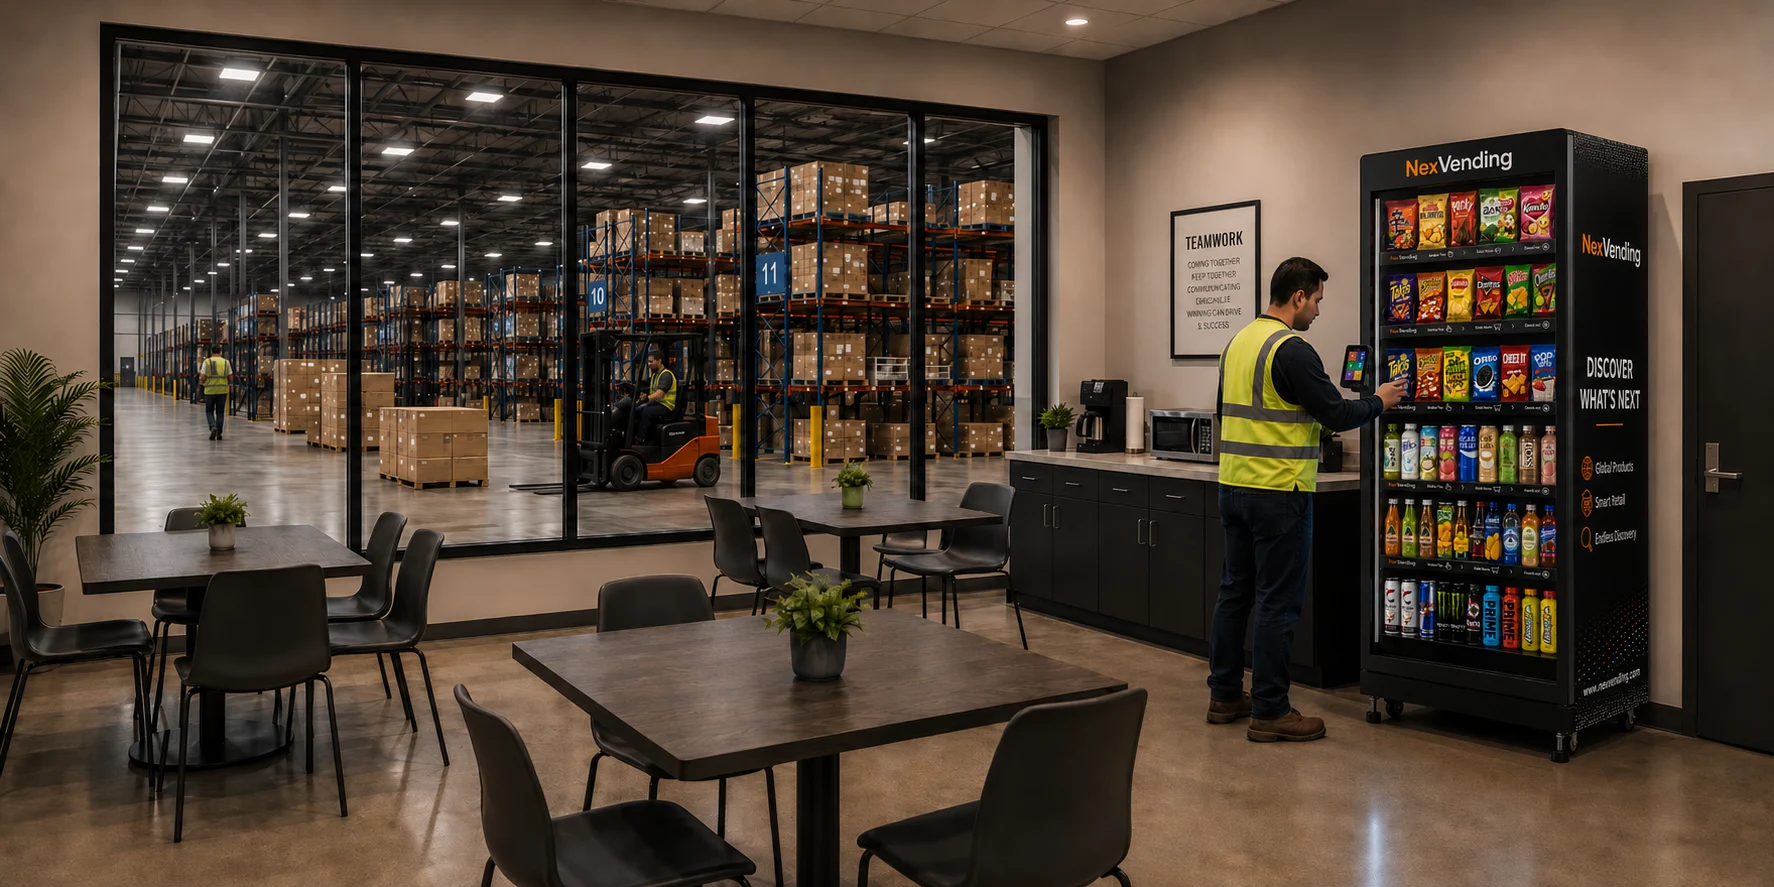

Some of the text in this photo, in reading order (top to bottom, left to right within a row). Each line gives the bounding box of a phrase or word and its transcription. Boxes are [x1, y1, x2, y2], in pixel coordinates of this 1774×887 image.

[1405, 150, 1512, 177] NexVending
[1185, 231, 1243, 250] TEAMWORK
[1582, 233, 1641, 268] NexVending
[762, 261, 777, 285] 11
[591, 287, 604, 305] 10
[1587, 356, 1633, 379] DISCOVER
[1580, 388, 1640, 410] WHAT'S NEXT
[1484, 600, 1496, 639] PRIME
